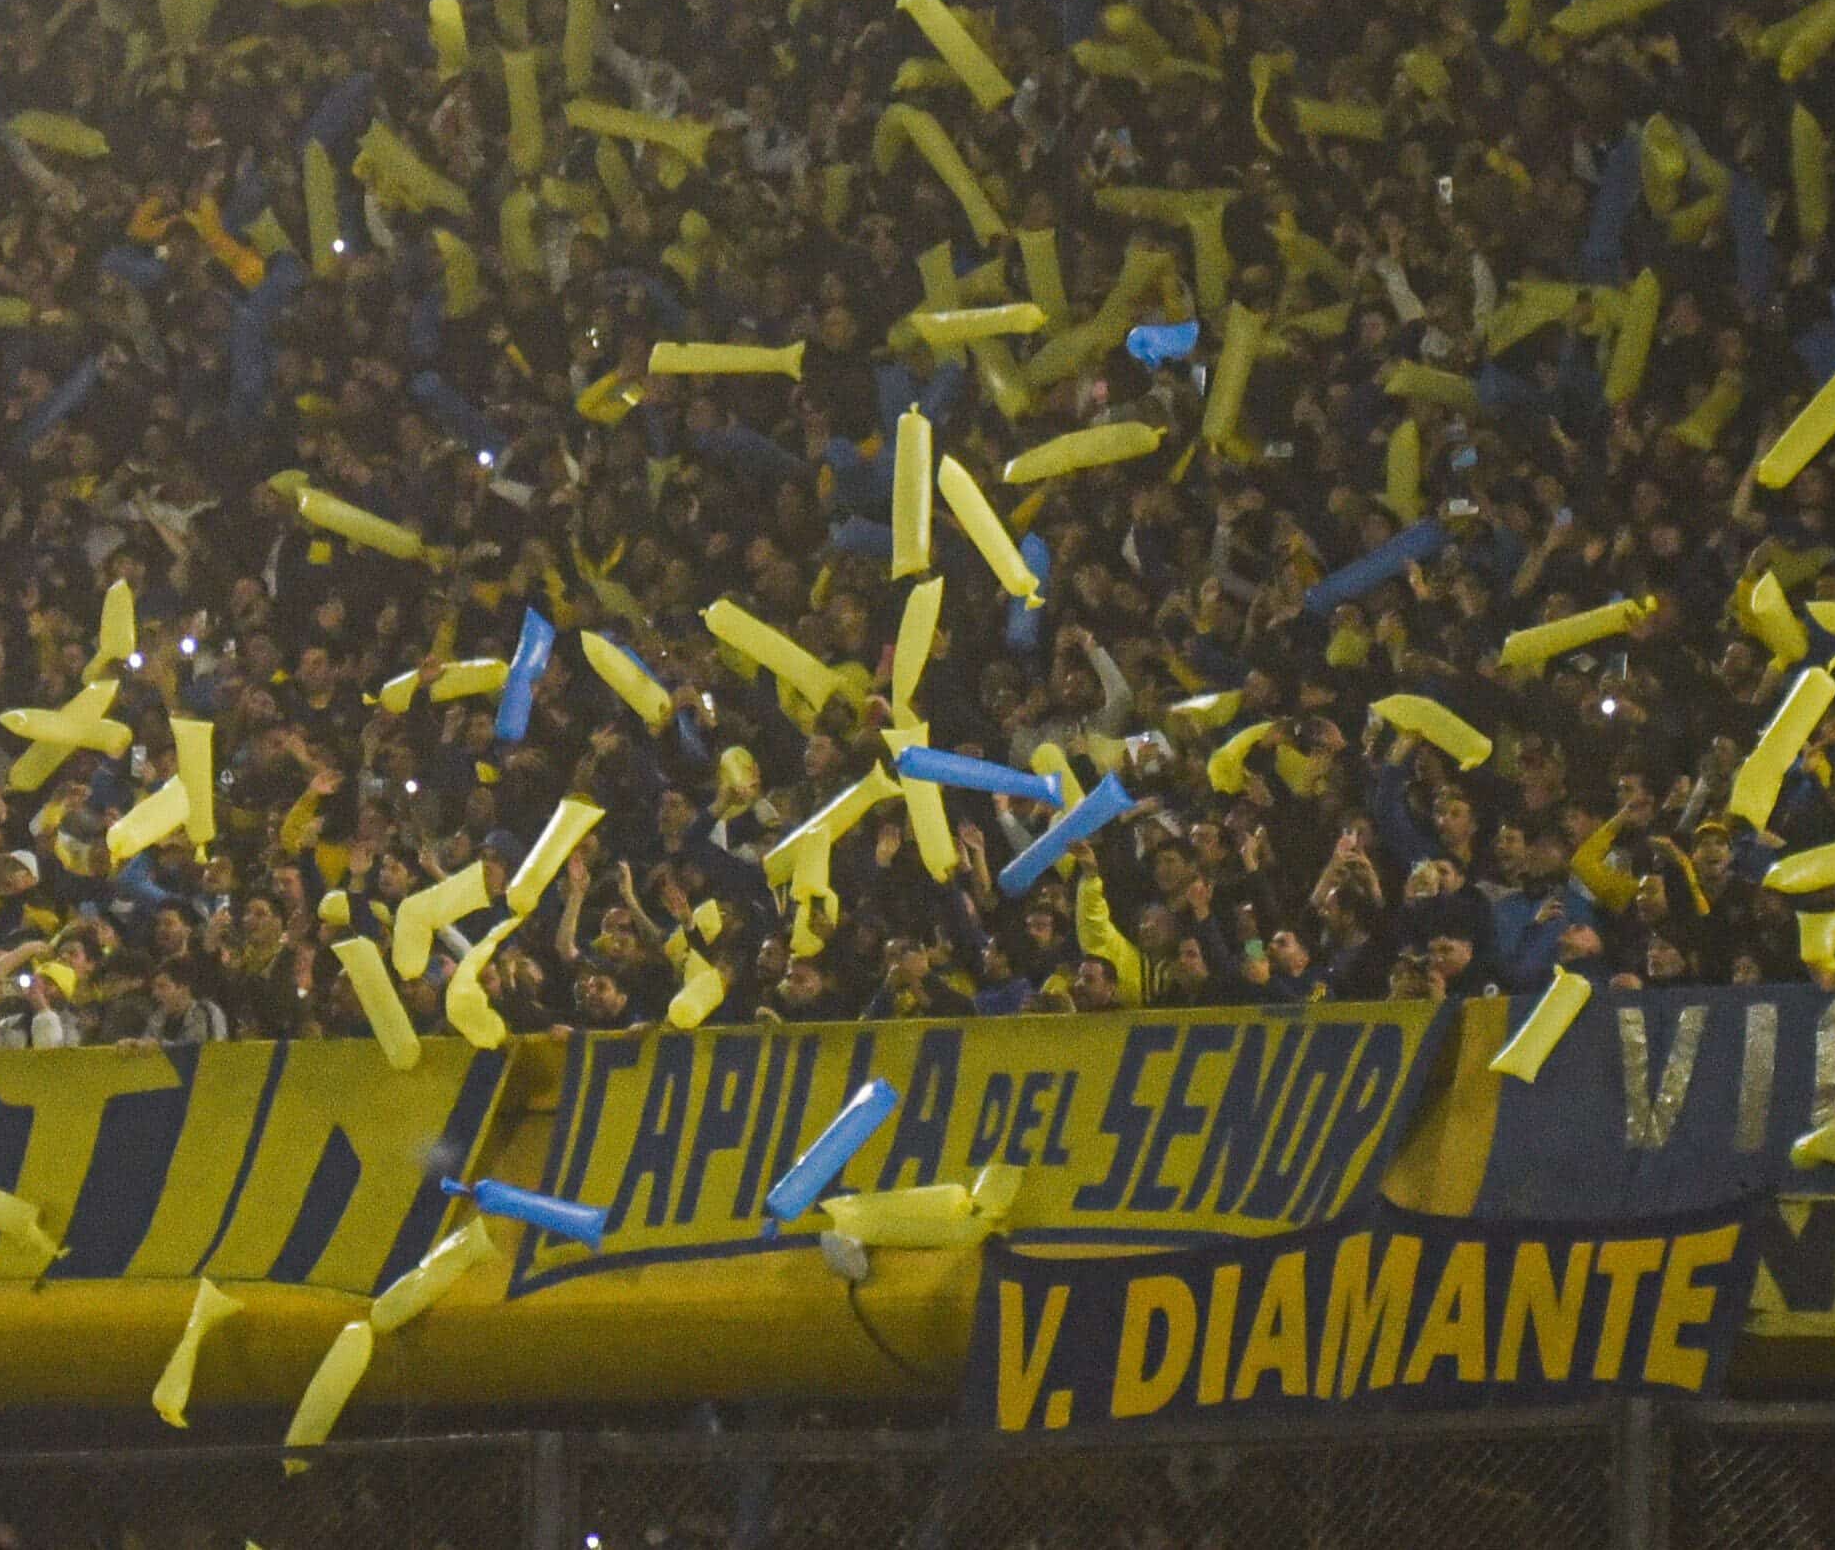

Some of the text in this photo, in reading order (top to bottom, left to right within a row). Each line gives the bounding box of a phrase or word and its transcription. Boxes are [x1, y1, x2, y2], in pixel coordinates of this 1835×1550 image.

[972, 1069, 1080, 1170] DEL
[996, 1220, 1746, 1433] V. DIAMANTE
